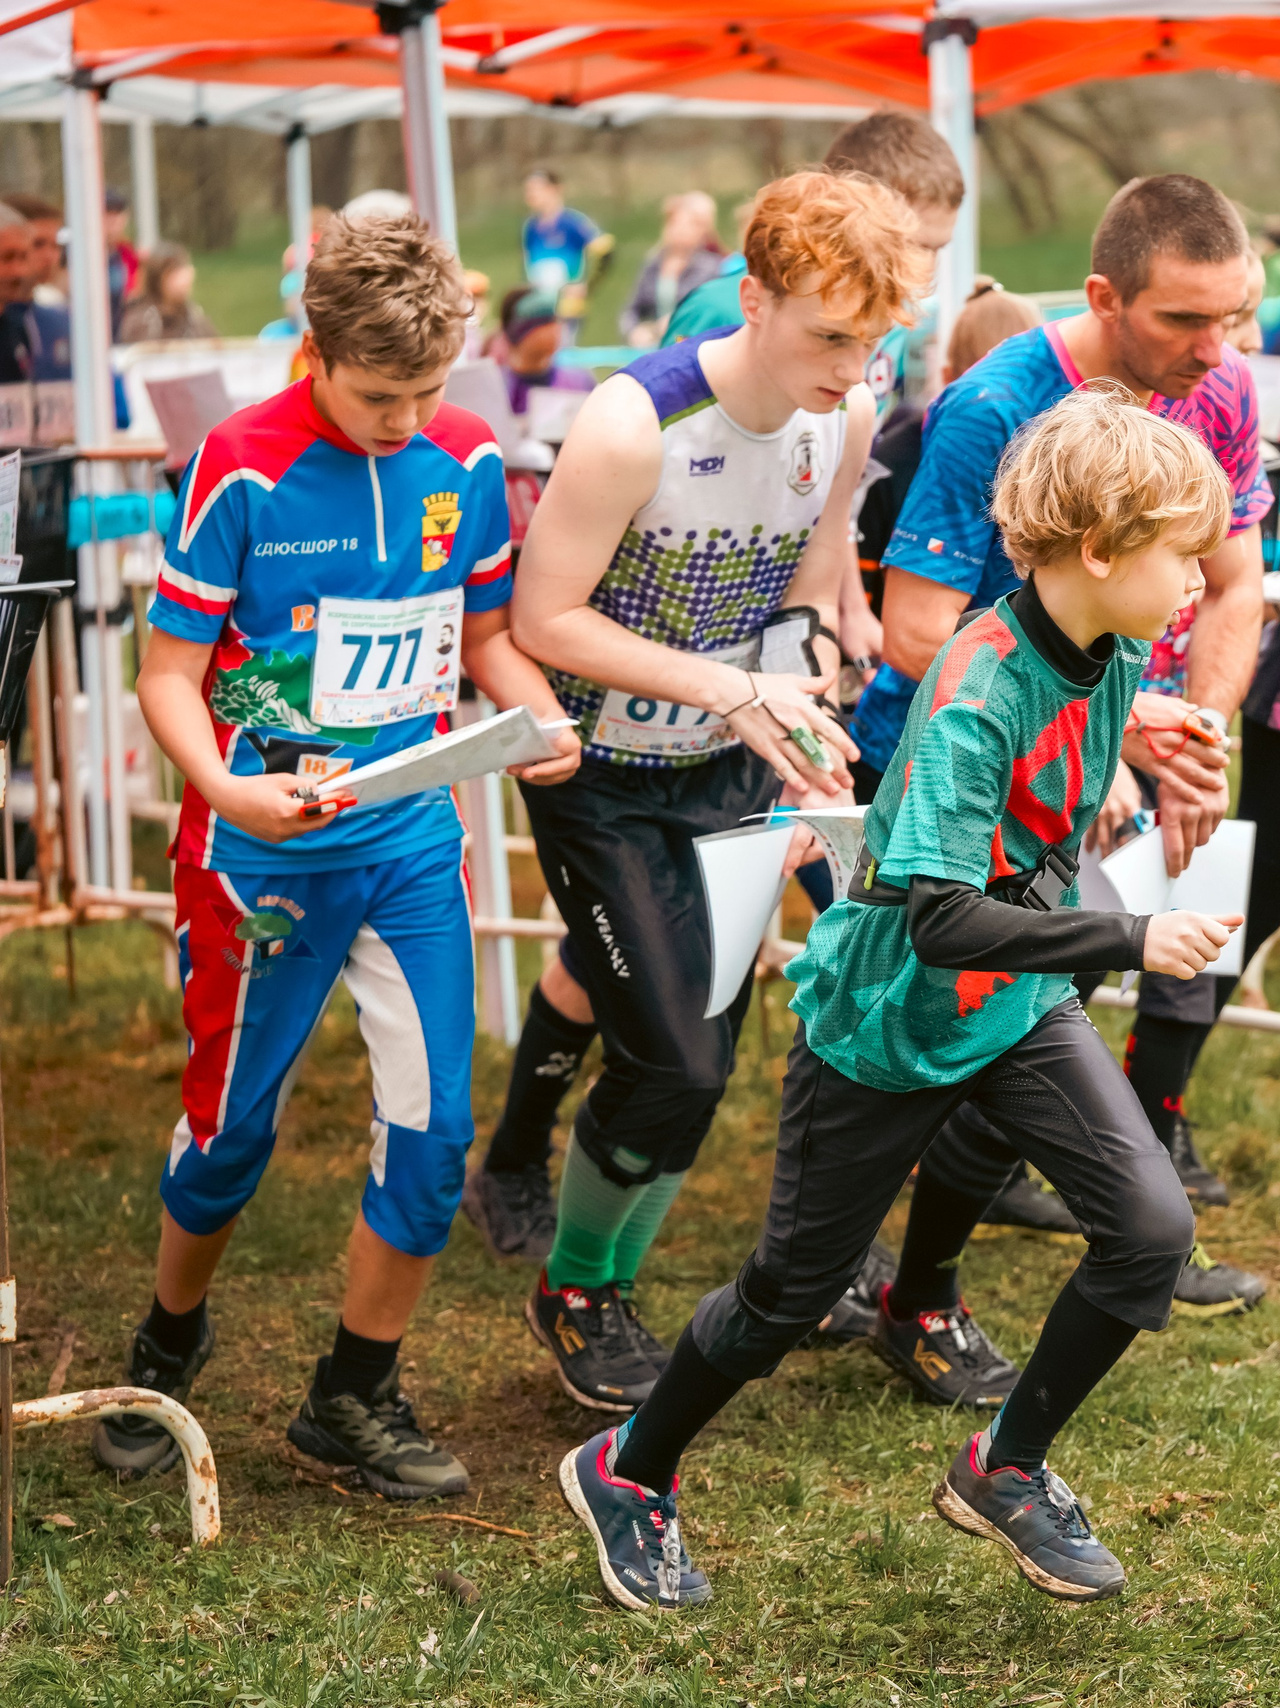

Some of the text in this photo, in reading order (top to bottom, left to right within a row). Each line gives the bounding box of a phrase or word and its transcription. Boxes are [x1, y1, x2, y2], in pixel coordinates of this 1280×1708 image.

[254, 537, 359, 557] СДЮСШОР 18
[341, 627, 423, 690] 777
[304, 758, 328, 775] 18
[623, 1567, 638, 1580] ULTRA
